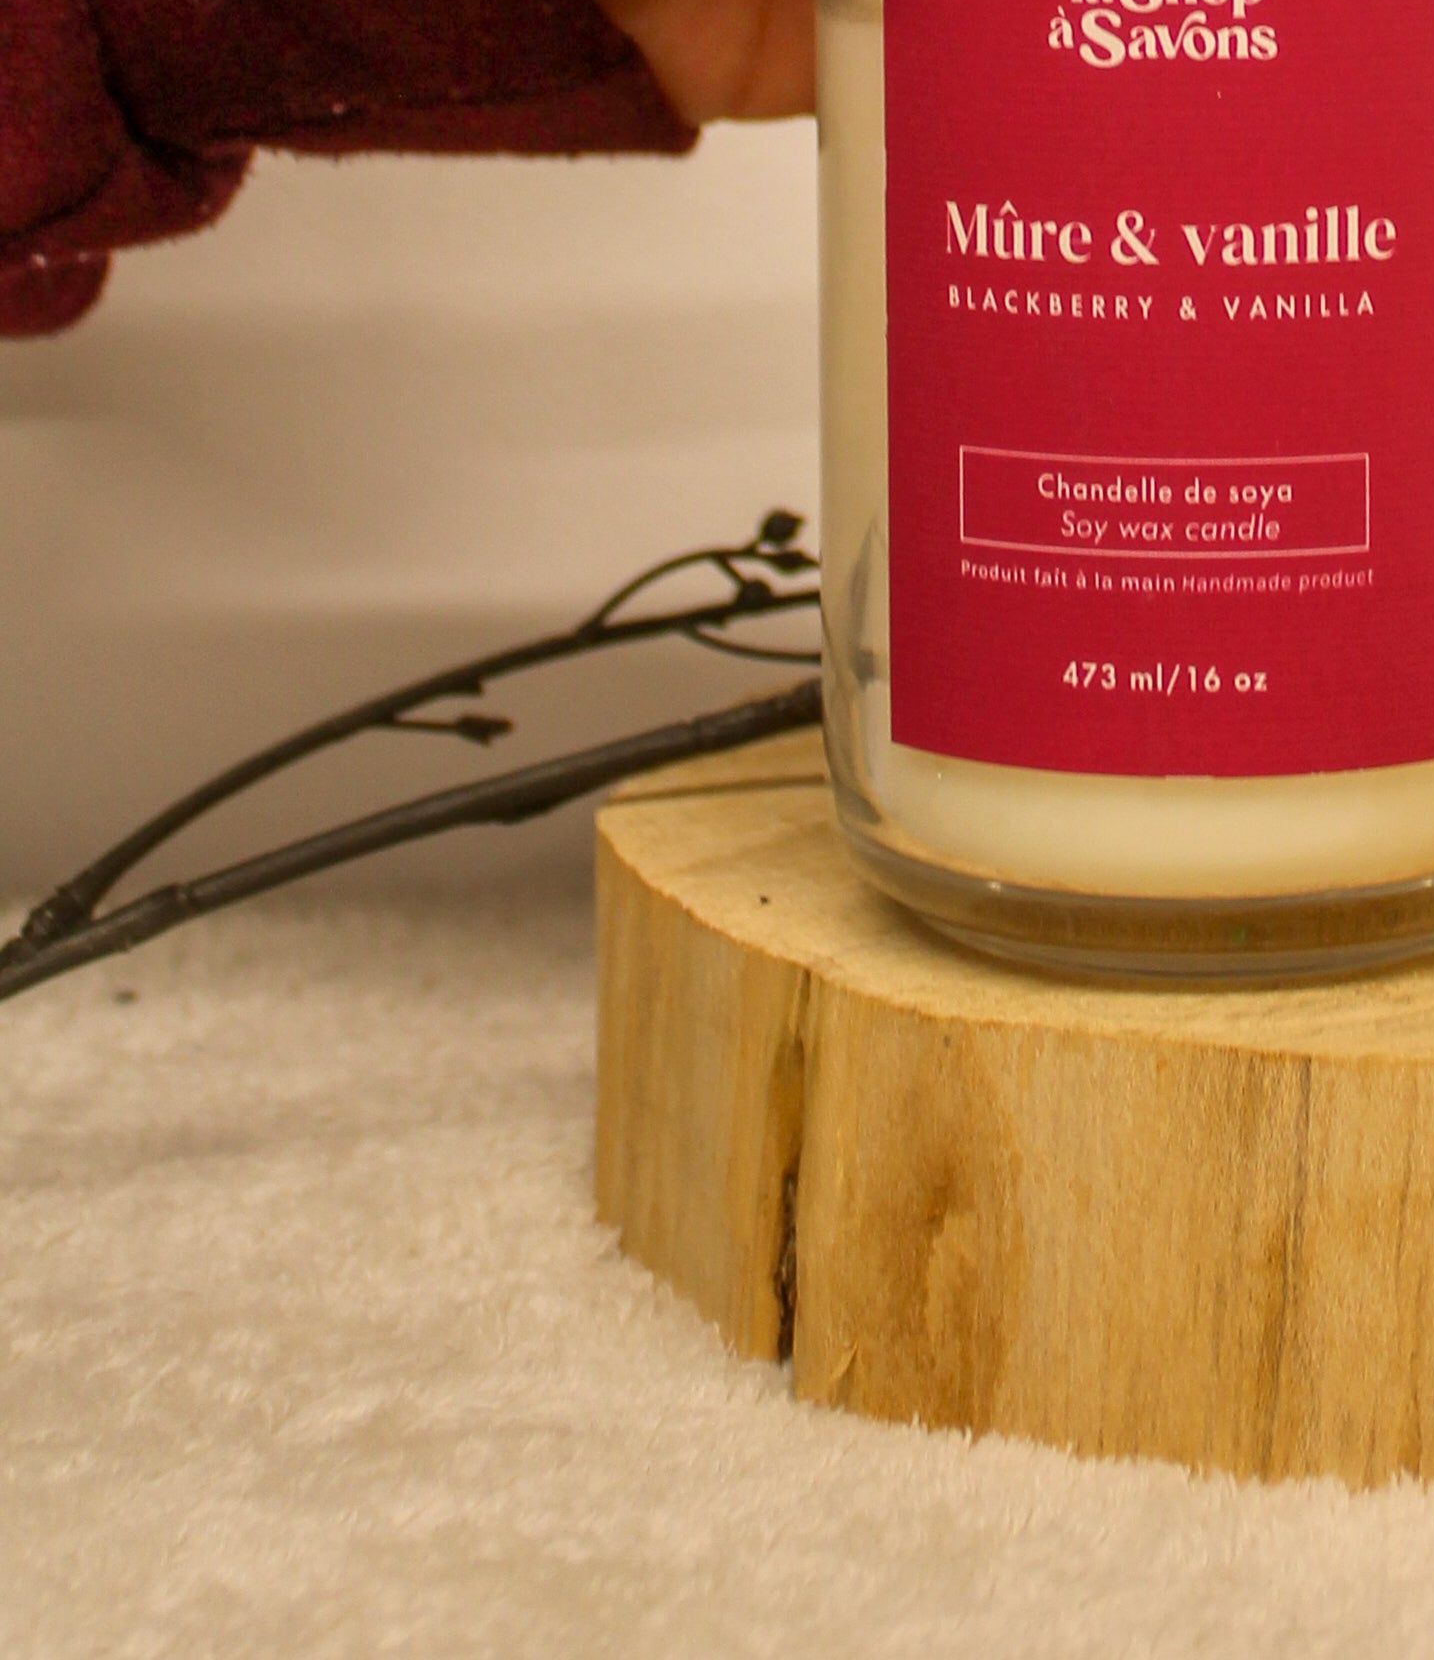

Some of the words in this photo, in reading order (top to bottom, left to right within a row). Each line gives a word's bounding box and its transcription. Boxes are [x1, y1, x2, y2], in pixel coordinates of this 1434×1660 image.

[1047, 5, 1074, 50] à
[1078, 7, 1278, 68] Savons
[945, 199, 1092, 265] Mûre
[1109, 208, 1160, 267] &
[1180, 203, 1397, 267] vanille
[947, 283, 1154, 321] BLACKBERRY
[1178, 294, 1198, 322] &
[1222, 289, 1375, 322] VANILLA
[1036, 471, 1173, 505] Chandelle
[1183, 475, 1218, 505] de
[1228, 484, 1293, 509] soya
[1060, 509, 1109, 544] Soy
[1119, 521, 1174, 541] wax
[1184, 513, 1281, 542] candle
[961, 559, 1027, 584] Produit
[1033, 566, 1068, 588] fait
[1076, 570, 1088, 589] à
[1094, 571, 1113, 591] la
[1121, 572, 1176, 592] main
[1182, 573, 1292, 593] Handmade
[1298, 567, 1374, 594] product
[1062, 660, 1117, 691] 473
[1129, 663, 1221, 696] ml/16
[1234, 671, 1268, 693] oz
